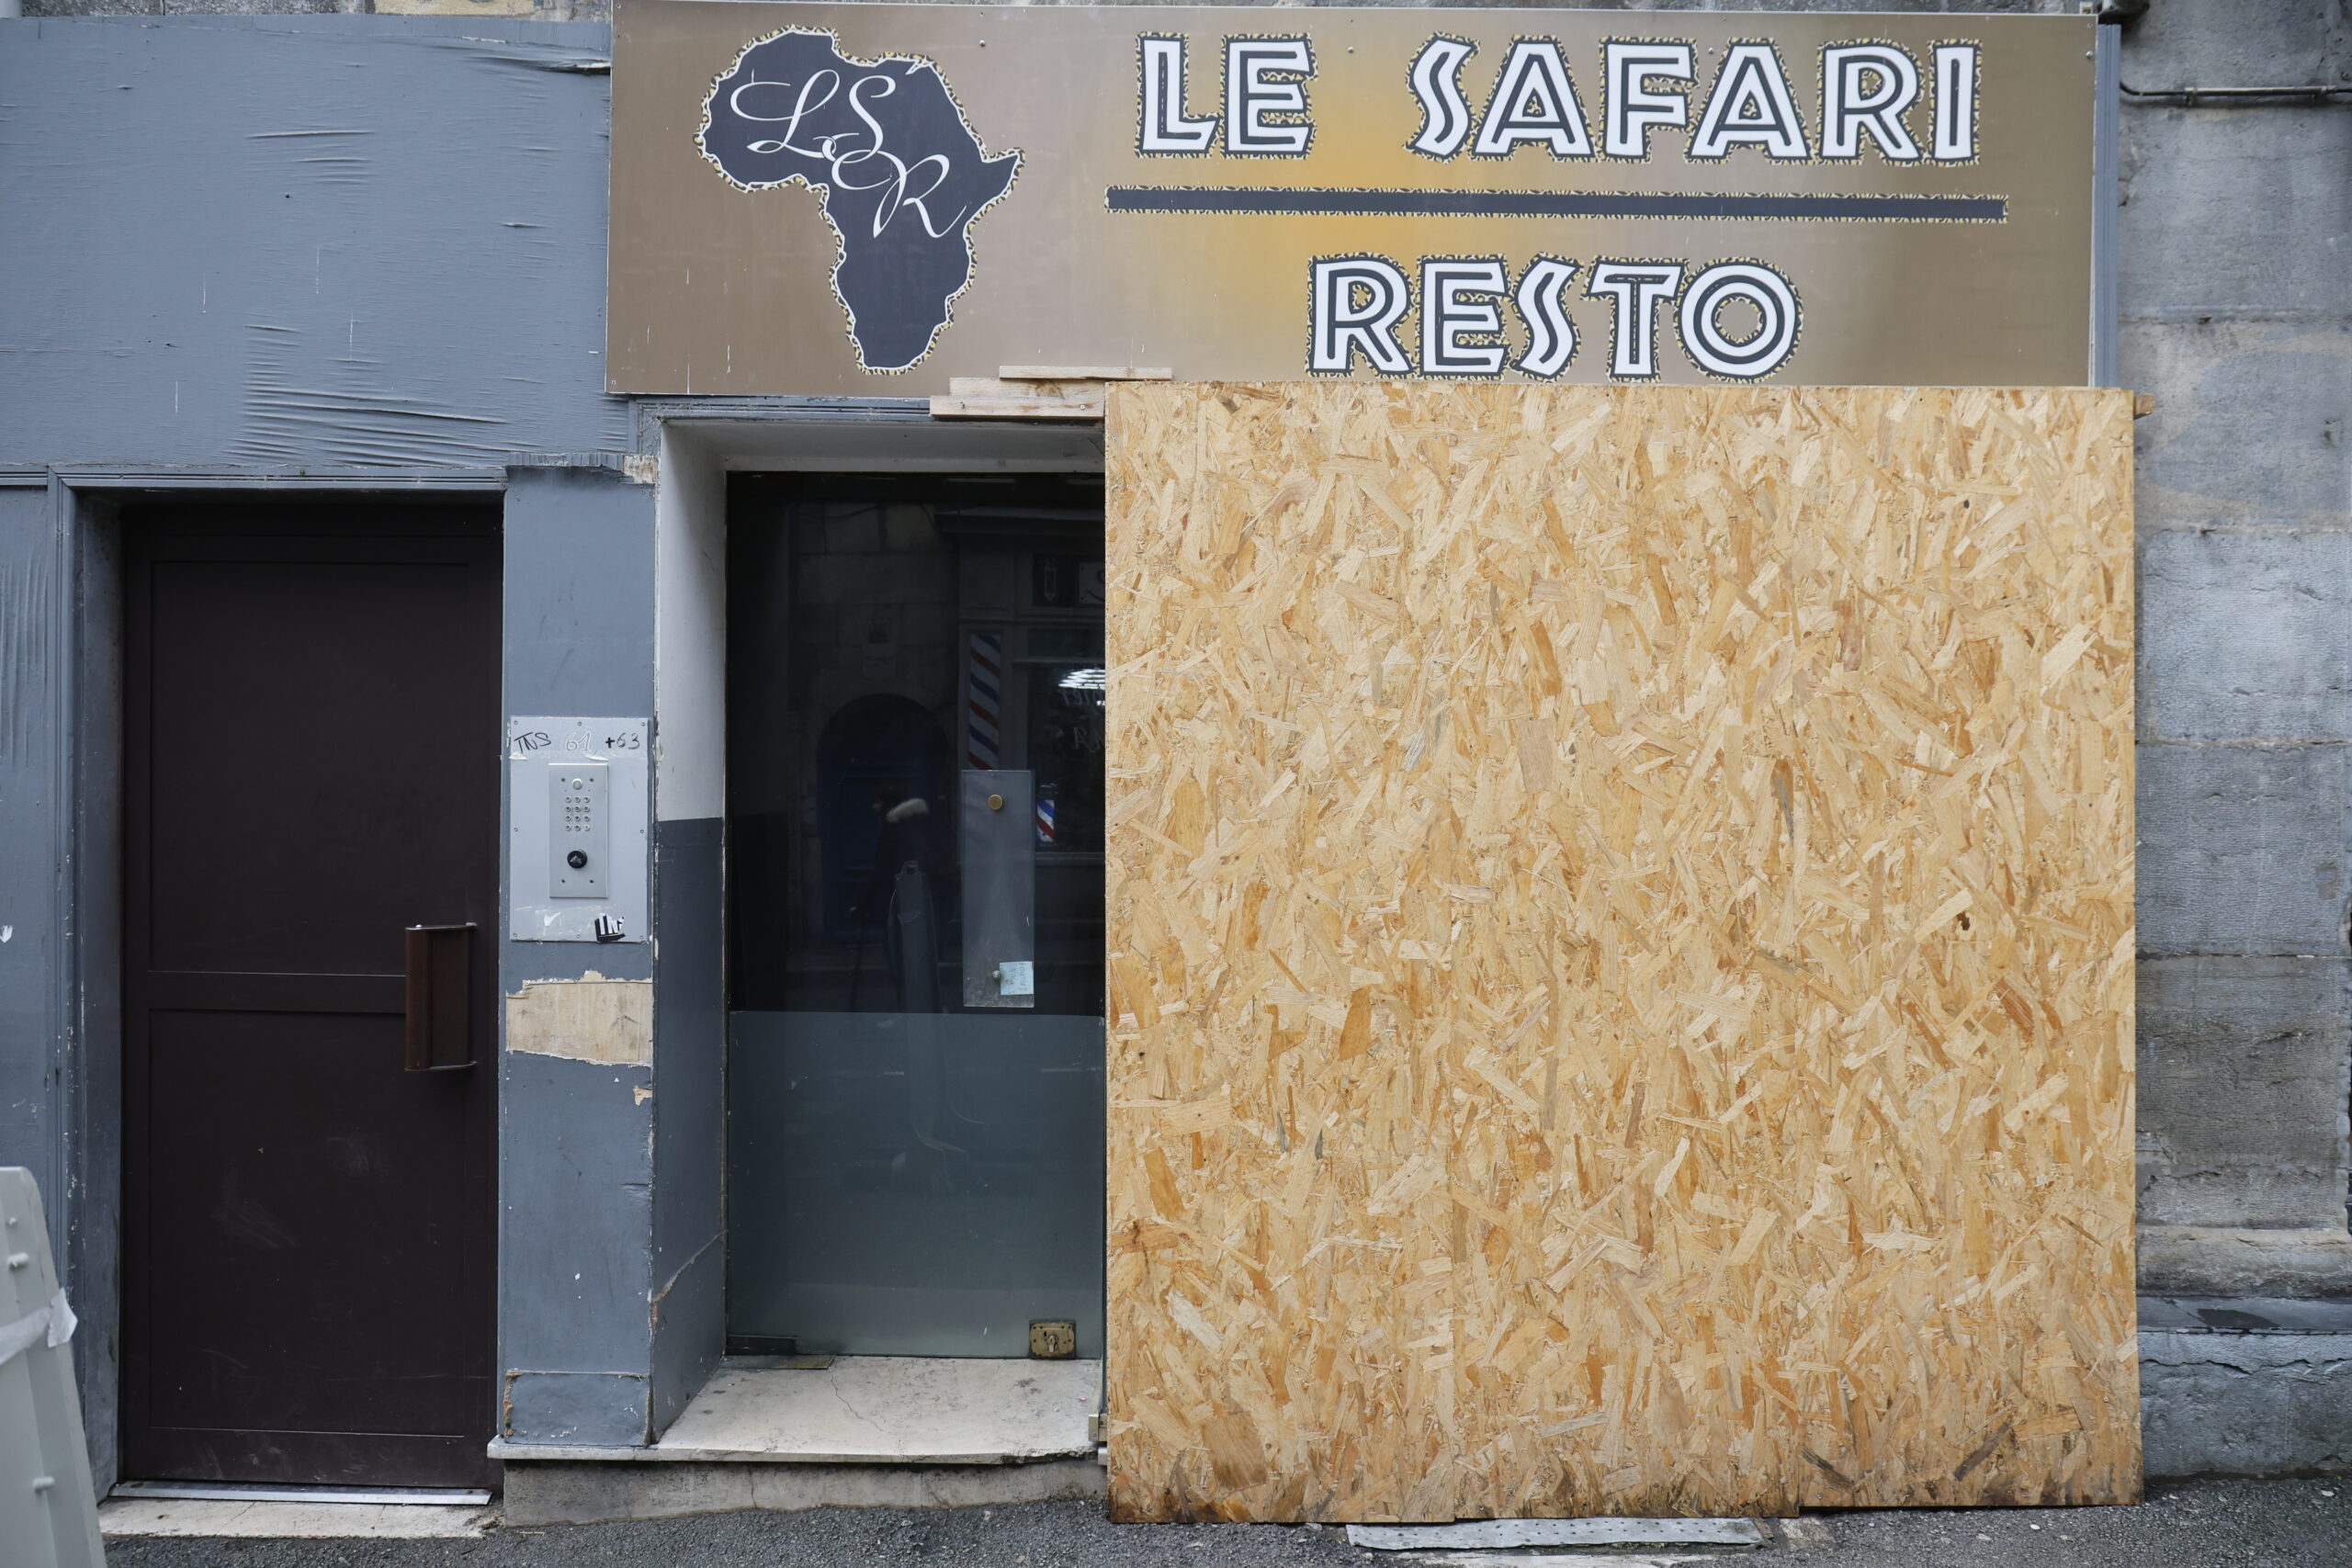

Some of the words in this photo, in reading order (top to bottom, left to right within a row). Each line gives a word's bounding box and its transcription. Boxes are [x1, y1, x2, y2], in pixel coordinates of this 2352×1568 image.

[1136, 33, 1317, 157] LE
[1405, 33, 1980, 164] SAFARI
[1306, 254, 1803, 381] RESTO
